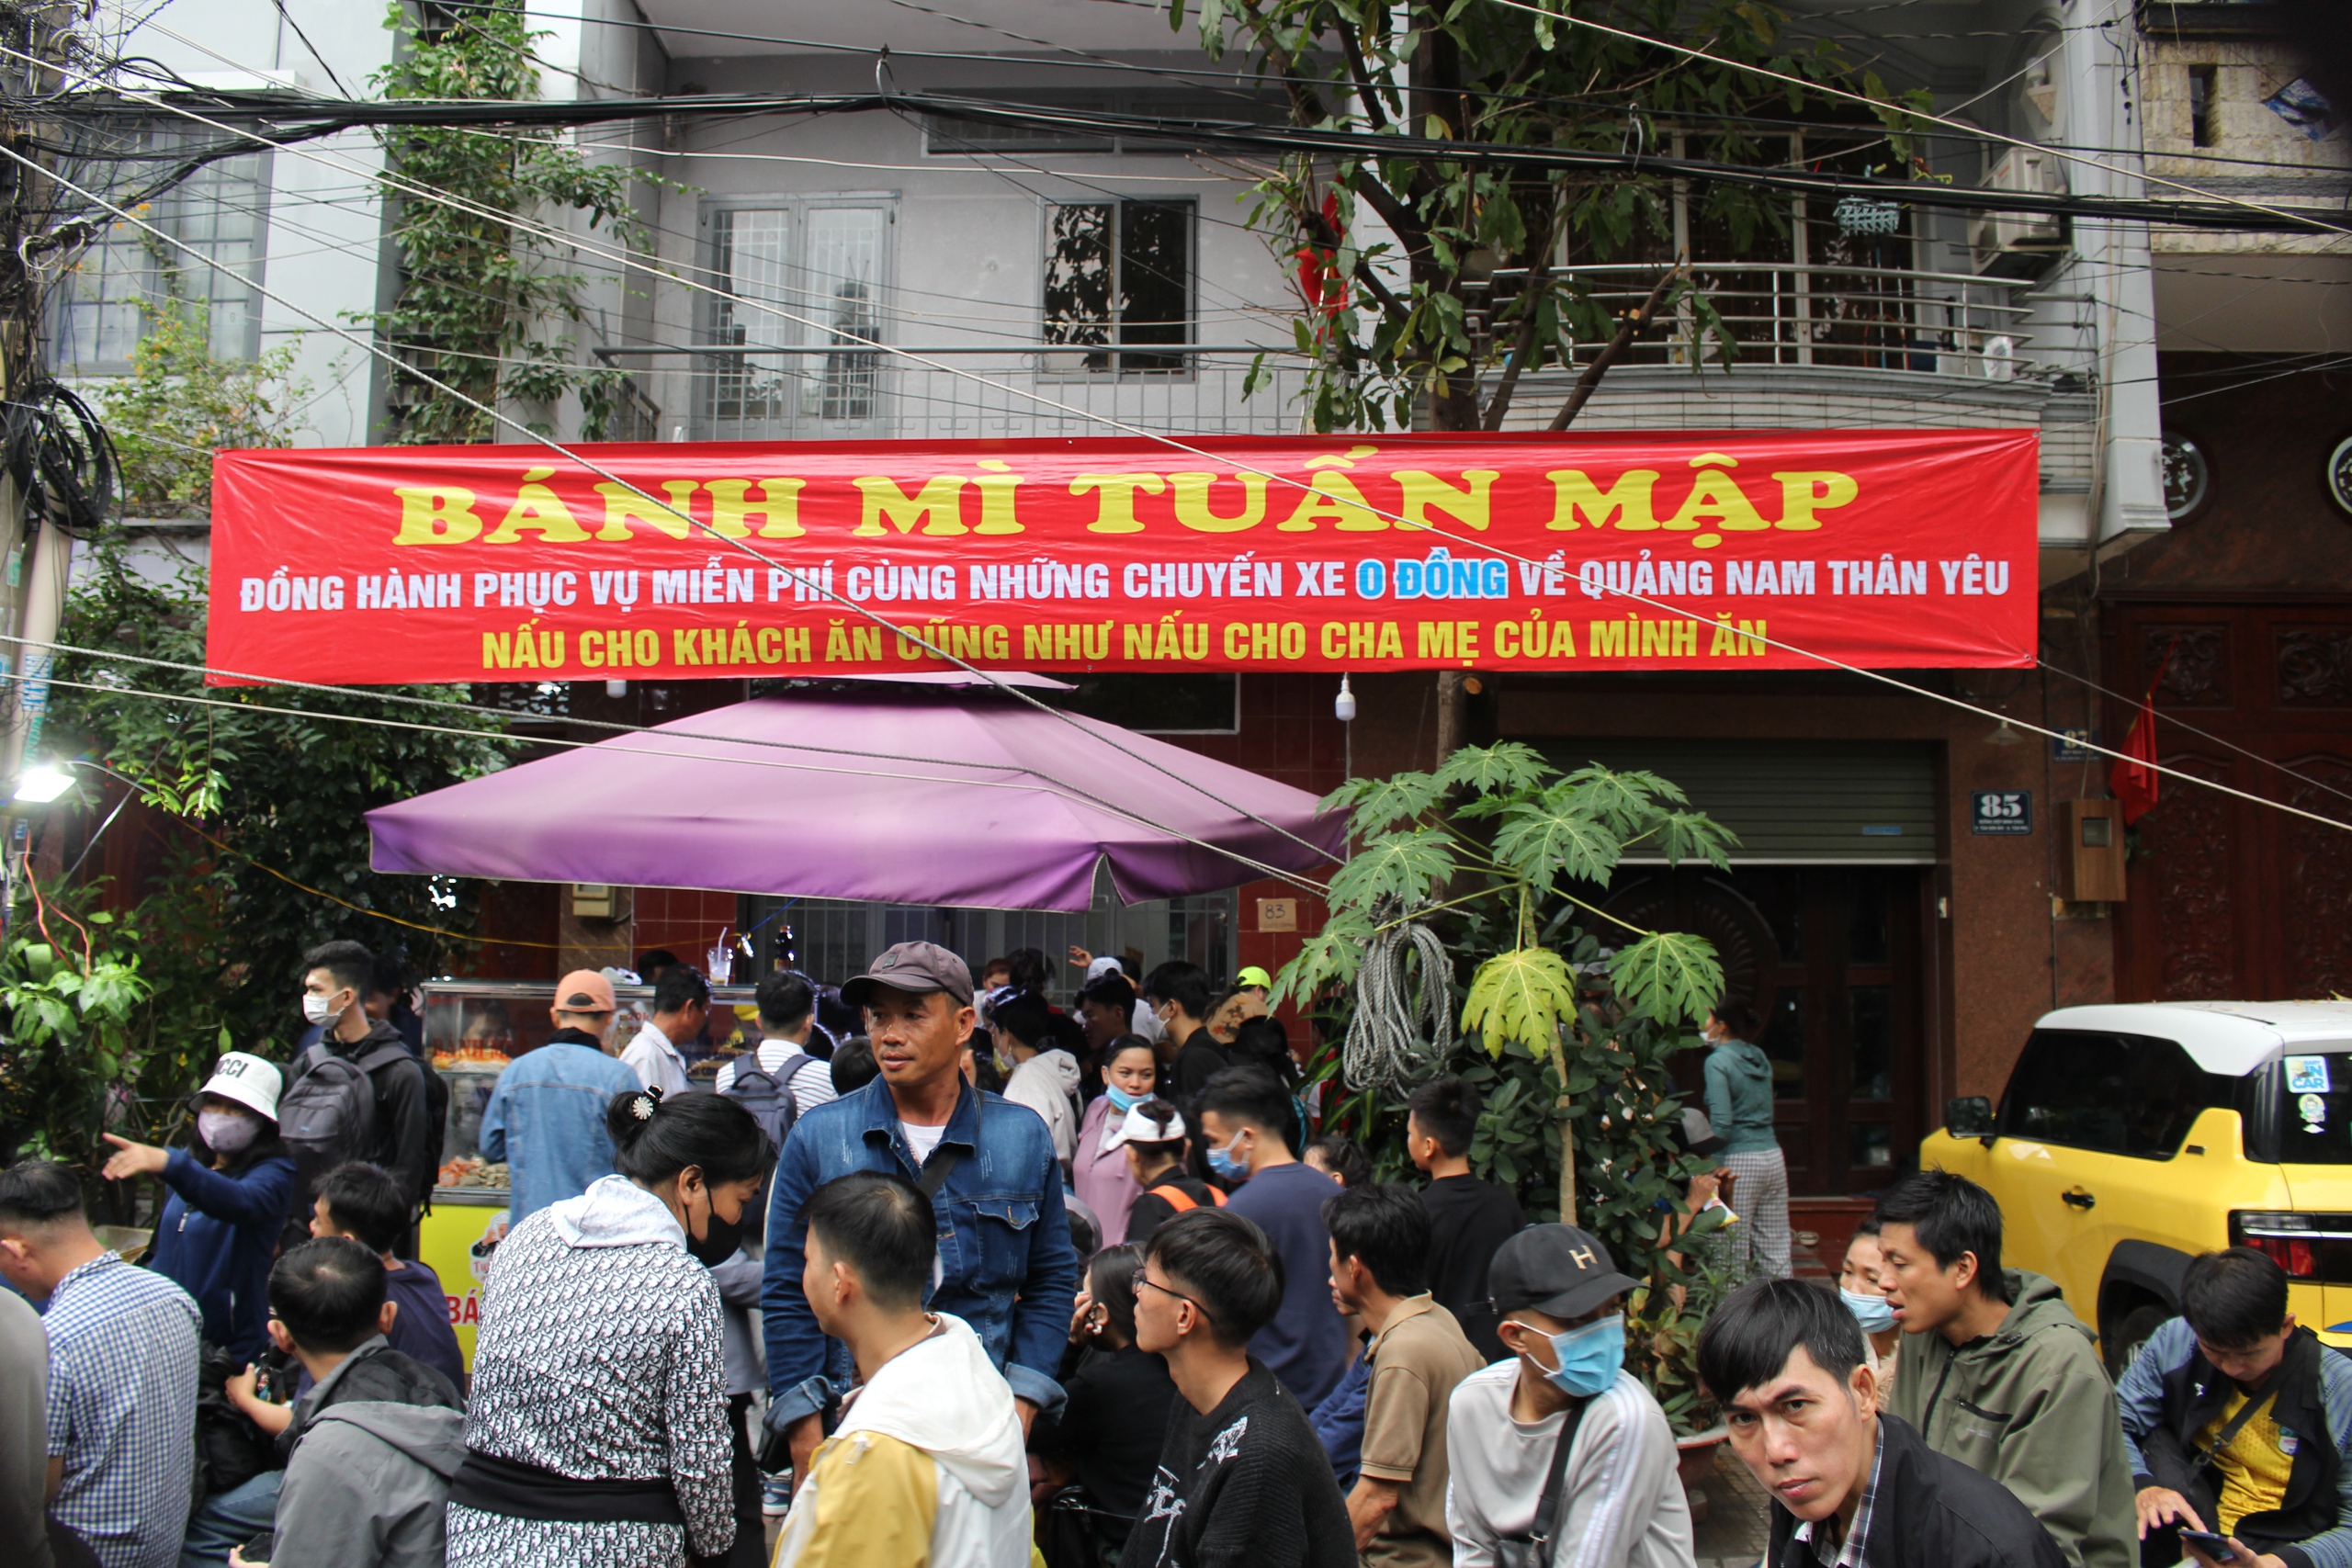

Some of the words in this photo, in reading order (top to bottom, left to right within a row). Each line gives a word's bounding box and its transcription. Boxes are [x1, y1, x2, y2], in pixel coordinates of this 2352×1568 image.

[392, 467, 807, 546] BÁNH
[853, 459, 1025, 537] MÌ
[1069, 445, 1500, 534] TUẤN
[1545, 451, 1859, 549] MẬP
[240, 566, 345, 613] ĐỒNG
[356, 568, 461, 611] HÀNH
[474, 570, 577, 615] PHỤC
[589, 570, 640, 614] VỤ
[651, 555, 754, 605] MIỄN
[767, 559, 834, 604] PHÍ
[845, 557, 956, 603] CÙNG
[969, 555, 1110, 601] NHỮNG
[1124, 551, 1283, 599] CHUYẾN
[1295, 561, 1346, 598] XE
[1393, 547, 1508, 601] ĐỒNG
[1519, 549, 1566, 597] VỀ
[1579, 548, 1713, 601] QUẢNG
[1726, 561, 1815, 596] NAM
[1827, 553, 1928, 596] THÂN
[1939, 553, 2010, 596] YÊU
[482, 617, 566, 670] NẤU
[579, 629, 661, 669] CHO
[674, 619, 812, 666] KHÁCH
[825, 619, 883, 663] ĂN
[897, 617, 1010, 662] CŨNG
[1024, 619, 1114, 661] NHƯ
[1124, 609, 1210, 661] NẤU
[1224, 622, 1307, 661] CHO
[1321, 622, 1405, 660] CHA
[1418, 621, 1480, 667] MẸ
[1494, 607, 1577, 659] CỦA
[1589, 612, 1698, 659] MÌNH
[1710, 612, 1768, 658] ĂN
[1980, 795, 2022, 818] 85
[1265, 904, 1285, 919] 83
[2292, 1077, 2325, 1089] CAR
[1568, 1245, 1599, 1270] H
[445, 1289, 479, 1325] BÁ
